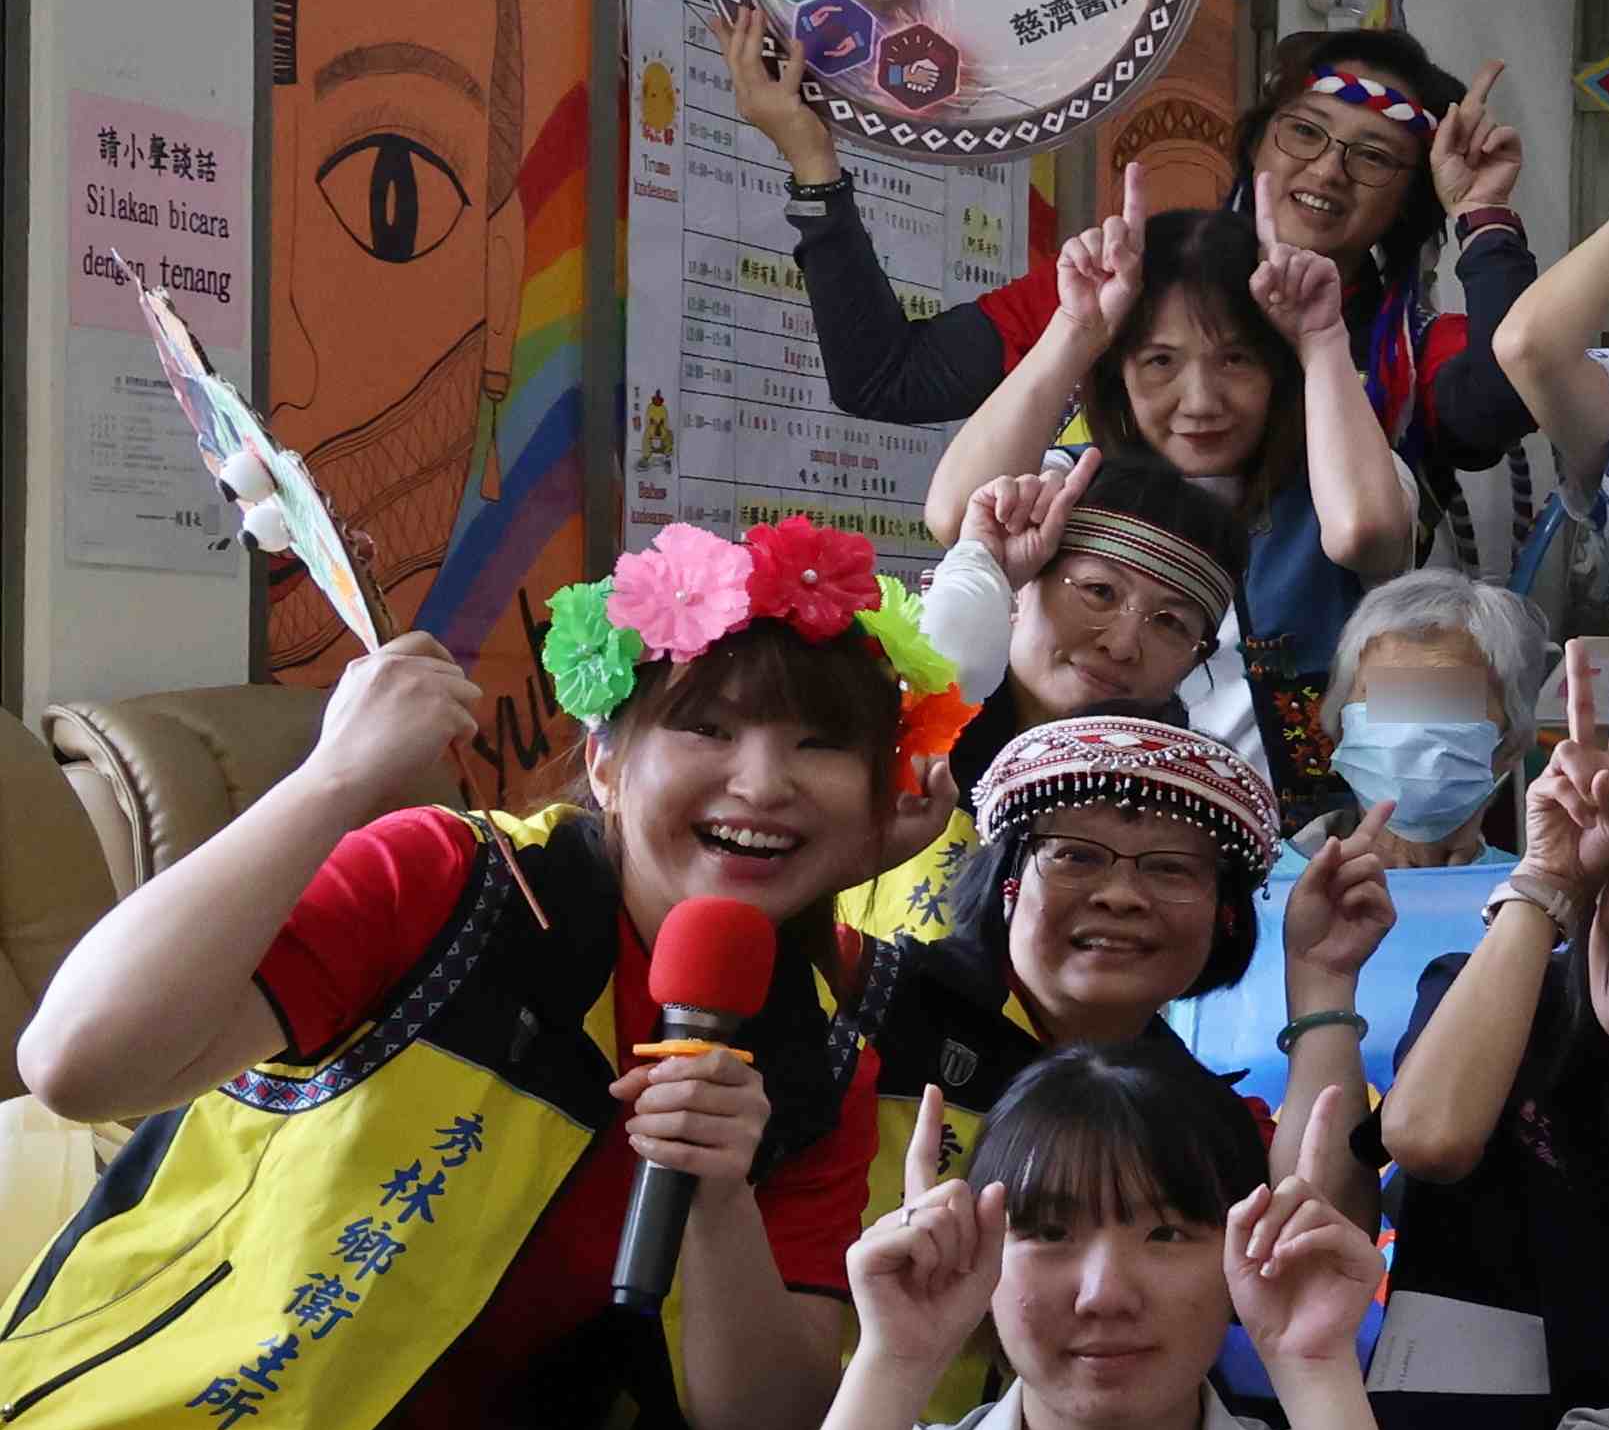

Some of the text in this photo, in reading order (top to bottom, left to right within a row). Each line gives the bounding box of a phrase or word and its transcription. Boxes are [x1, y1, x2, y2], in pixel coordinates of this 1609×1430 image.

[97, 126, 217, 183] 請小聲談話
[87, 183, 230, 239] Silakan bicara
[160, 255, 231, 304] tenang
[890, 837, 968, 937] 秀林
